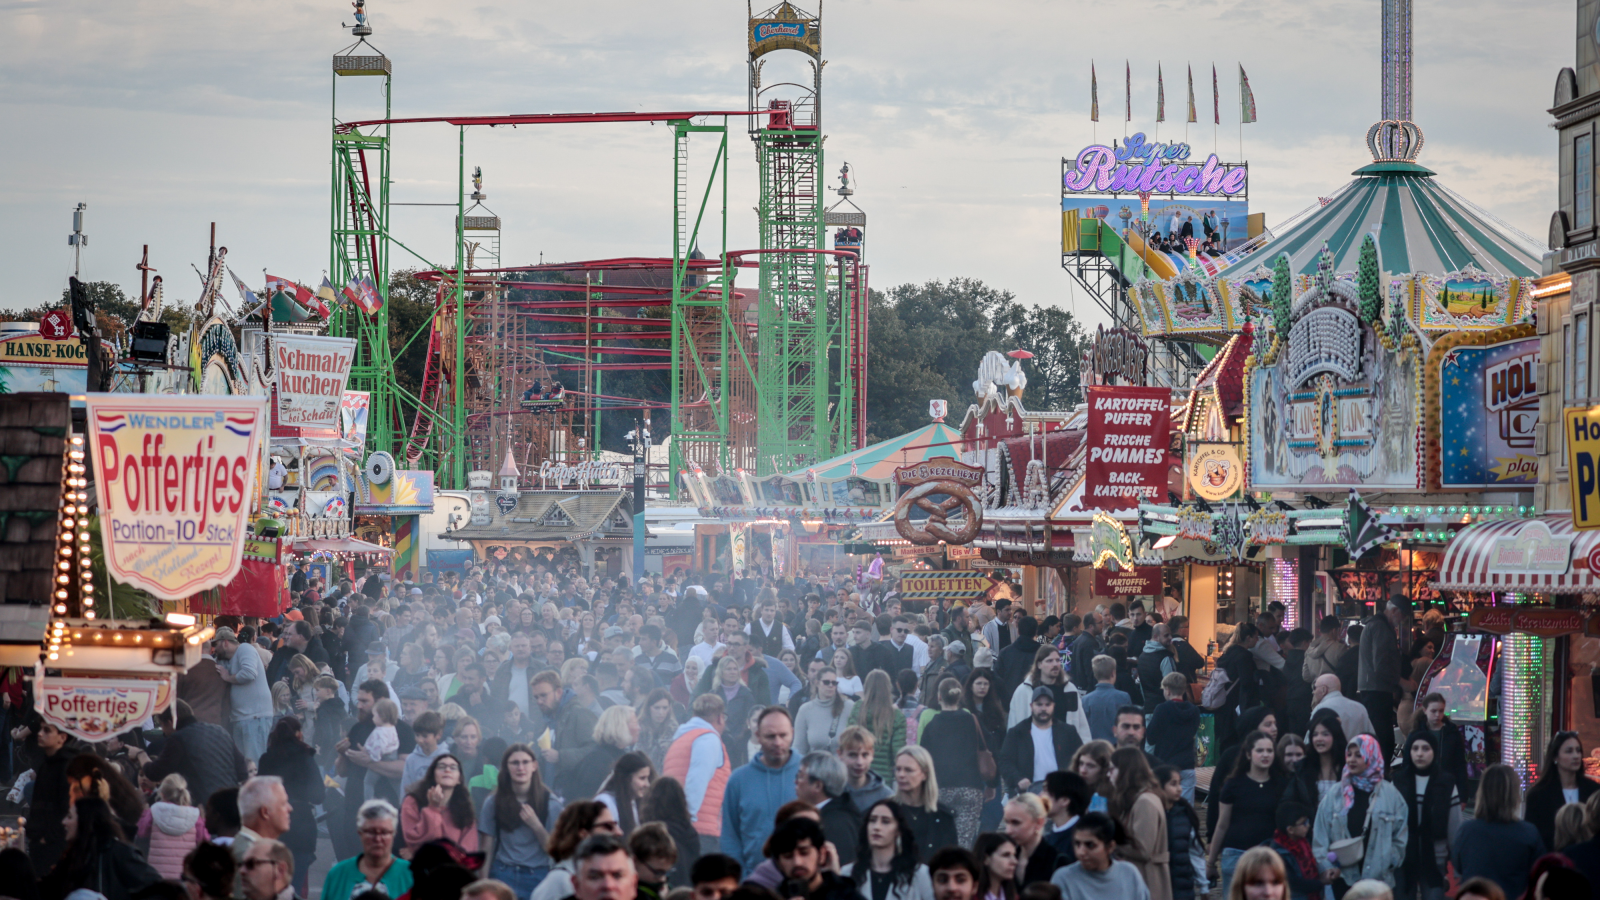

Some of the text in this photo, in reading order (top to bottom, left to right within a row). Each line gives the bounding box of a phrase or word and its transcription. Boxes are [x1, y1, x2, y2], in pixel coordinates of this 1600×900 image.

[759, 24, 799, 38] Eberhard
[1116, 132, 1191, 166] Super
[1064, 144, 1247, 195] Rutsche
[5, 341, 89, 359] HANSE-KOG
[279, 346, 350, 374] Schmalz-
[280, 371, 341, 396] kuchen
[1491, 360, 1538, 406] HOL
[1095, 397, 1169, 411] KARTOFFEL-
[288, 413, 300, 423] bei
[301, 405, 339, 421] Schau!
[1104, 412, 1152, 426] PUFFER
[1574, 416, 1600, 441] Ho
[1103, 434, 1152, 446] FRISCHE
[1090, 447, 1165, 464] POMMES
[1193, 451, 1210, 477] KARTOFFEL
[901, 465, 980, 480] DIE BREZELHEXE
[1108, 471, 1145, 484] BACK-
[99, 433, 247, 535] Poffertjes
[1093, 484, 1159, 497] KARTOFFEL
[952, 548, 963, 556] Eis
[905, 578, 982, 592] TOILETTEN
[1107, 578, 1150, 586] KARTOFFEL-
[1114, 585, 1142, 594] PUFFER
[47, 694, 139, 718] Poffertjes
